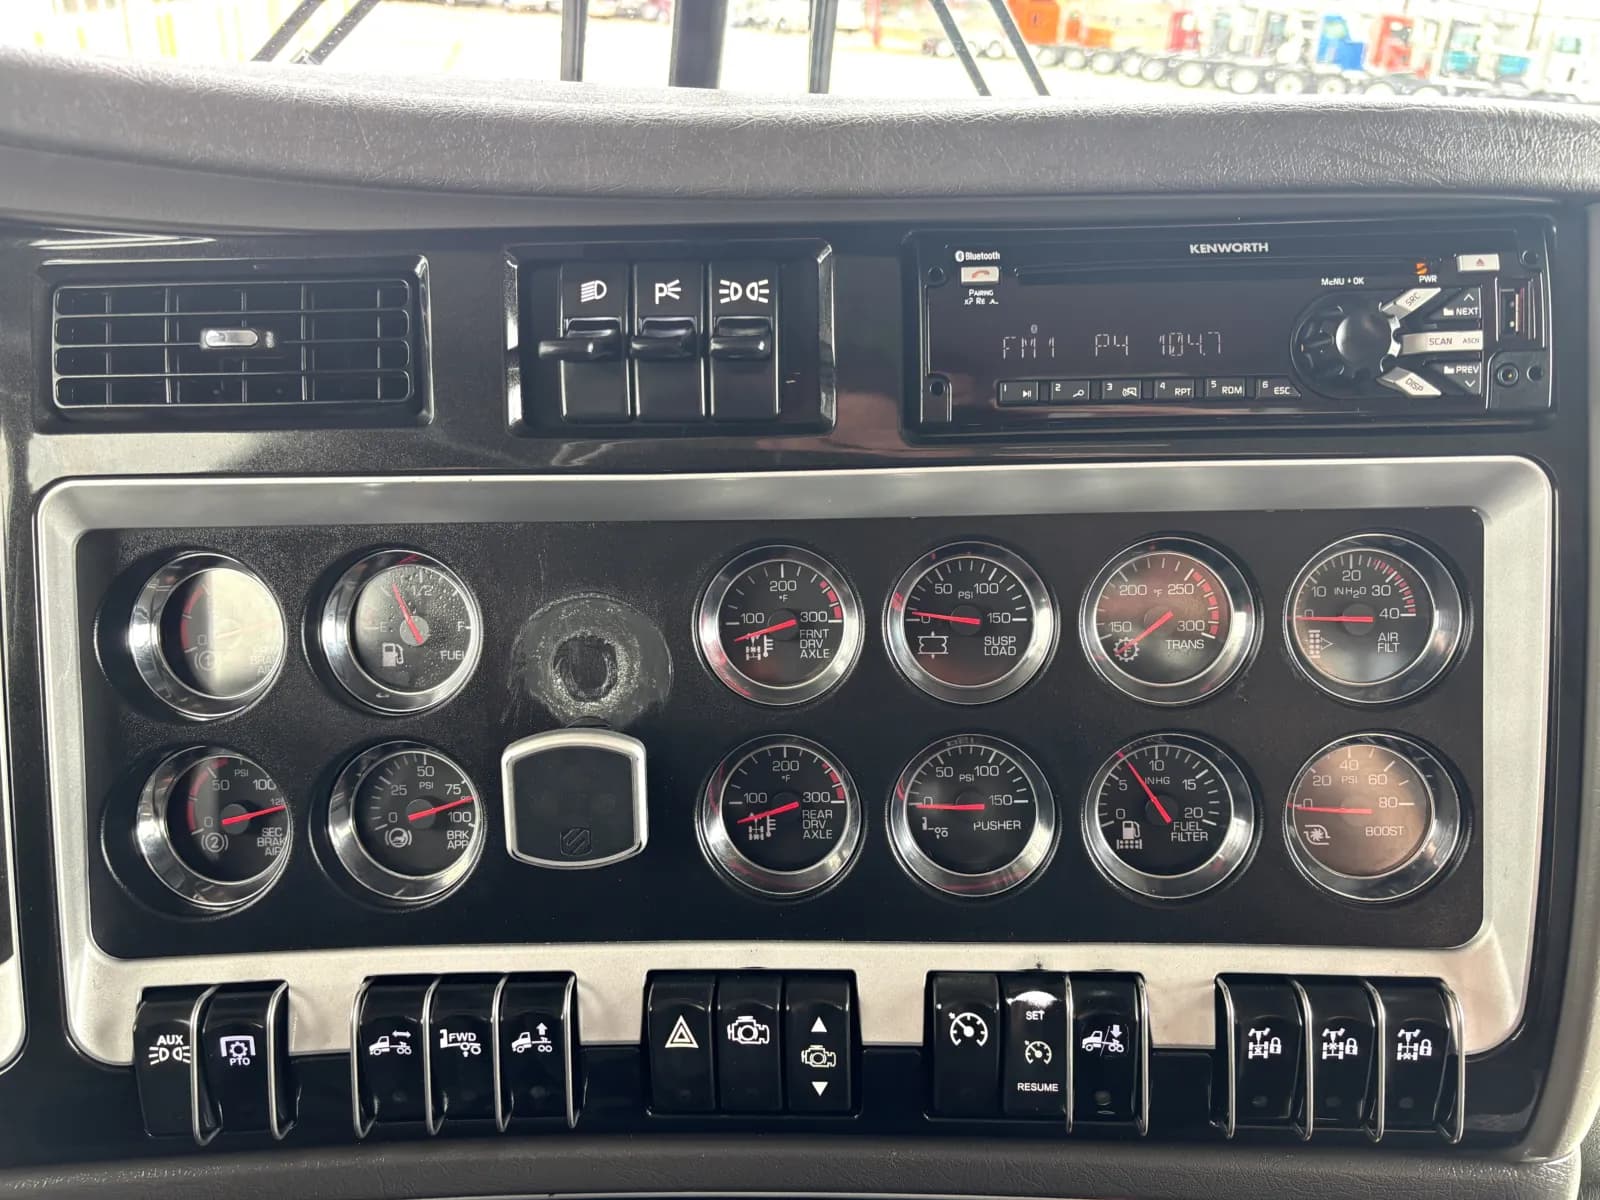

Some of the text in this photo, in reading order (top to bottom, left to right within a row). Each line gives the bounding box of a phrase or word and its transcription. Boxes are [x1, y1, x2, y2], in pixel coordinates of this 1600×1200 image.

[1189, 242, 1269, 254] KENWORTH
[965, 251, 1001, 261] Bluetooth
[1352, 276, 1365, 285] OK
[1418, 275, 1437, 283] PWR
[1405, 293, 1421, 307] SRC
[1456, 307, 1479, 316] NEXT
[1095, 333, 1128, 357] P4
[1428, 338, 1453, 346] SCAN
[1456, 366, 1479, 374] PREV
[1055, 383, 1062, 392] 2
[1106, 382, 1113, 391] 3
[1159, 381, 1192, 397] 4 RPT
[1210, 380, 1218, 389] 5
[1262, 380, 1291, 395] 6 ESC
[1405, 377, 1424, 392] DISP
[1342, 570, 1361, 581] 20
[412, 585, 434, 596] 1/2
[769, 580, 797, 592] 200
[934, 584, 953, 594] 50
[974, 583, 999, 594] 100
[1119, 585, 1147, 595] 200
[1168, 584, 1194, 595] 250
[1312, 586, 1327, 597] 10
[1371, 585, 1391, 596] 30
[741, 613, 764, 623] 100
[800, 611, 828, 622] 300
[987, 613, 1011, 623] 150
[1379, 608, 1399, 619] 40
[1109, 622, 1132, 632] 150
[1177, 620, 1205, 631] 300
[800, 629, 829, 638] FRNT
[1377, 632, 1398, 641] AIR
[800, 639, 823, 648] DRV
[984, 636, 1016, 646] SUSP
[1166, 639, 1204, 649] TRANS
[800, 649, 830, 658] AXLE
[984, 646, 1017, 656] LOAD
[1377, 643, 1400, 653] FILT
[772, 760, 800, 772] 200
[974, 765, 1000, 776] 100
[1149, 760, 1165, 771] 10
[1339, 760, 1359, 771] 40
[417, 766, 434, 777] 50
[935, 767, 954, 778] 50
[959, 774, 974, 782] PSI
[1312, 775, 1332, 786] 20
[1341, 776, 1358, 784] PSI
[1368, 774, 1388, 785] 60
[212, 780, 230, 791] 50
[252, 780, 277, 791] 100
[391, 784, 407, 796] 25
[445, 784, 461, 795] 75
[1119, 780, 1128, 791] 5
[1182, 779, 1196, 790] 15
[744, 792, 768, 803] 100
[802, 792, 831, 803] 300
[989, 794, 1013, 805] 150
[1379, 797, 1398, 808] 80
[388, 812, 398, 823] 0
[447, 811, 472, 823] 100
[802, 810, 833, 819] REAR
[1116, 808, 1126, 819] 0
[1184, 807, 1203, 819] 20
[204, 817, 214, 828] 0
[802, 820, 826, 829] DRV
[973, 820, 1022, 831] PUSHER
[1173, 821, 1203, 831] FUEL
[262, 827, 282, 837] SEC
[447, 830, 469, 840] BRK
[803, 829, 833, 839] AXLE
[1171, 832, 1209, 841] FILTER
[1365, 826, 1405, 837] BOOST
[447, 840, 469, 849] APP
[1026, 1010, 1045, 1020] SET
[156, 1034, 184, 1046] AUX
[448, 1032, 477, 1042] FWD
[229, 1057, 251, 1066] PTO
[1017, 1083, 1059, 1092] RESUME
